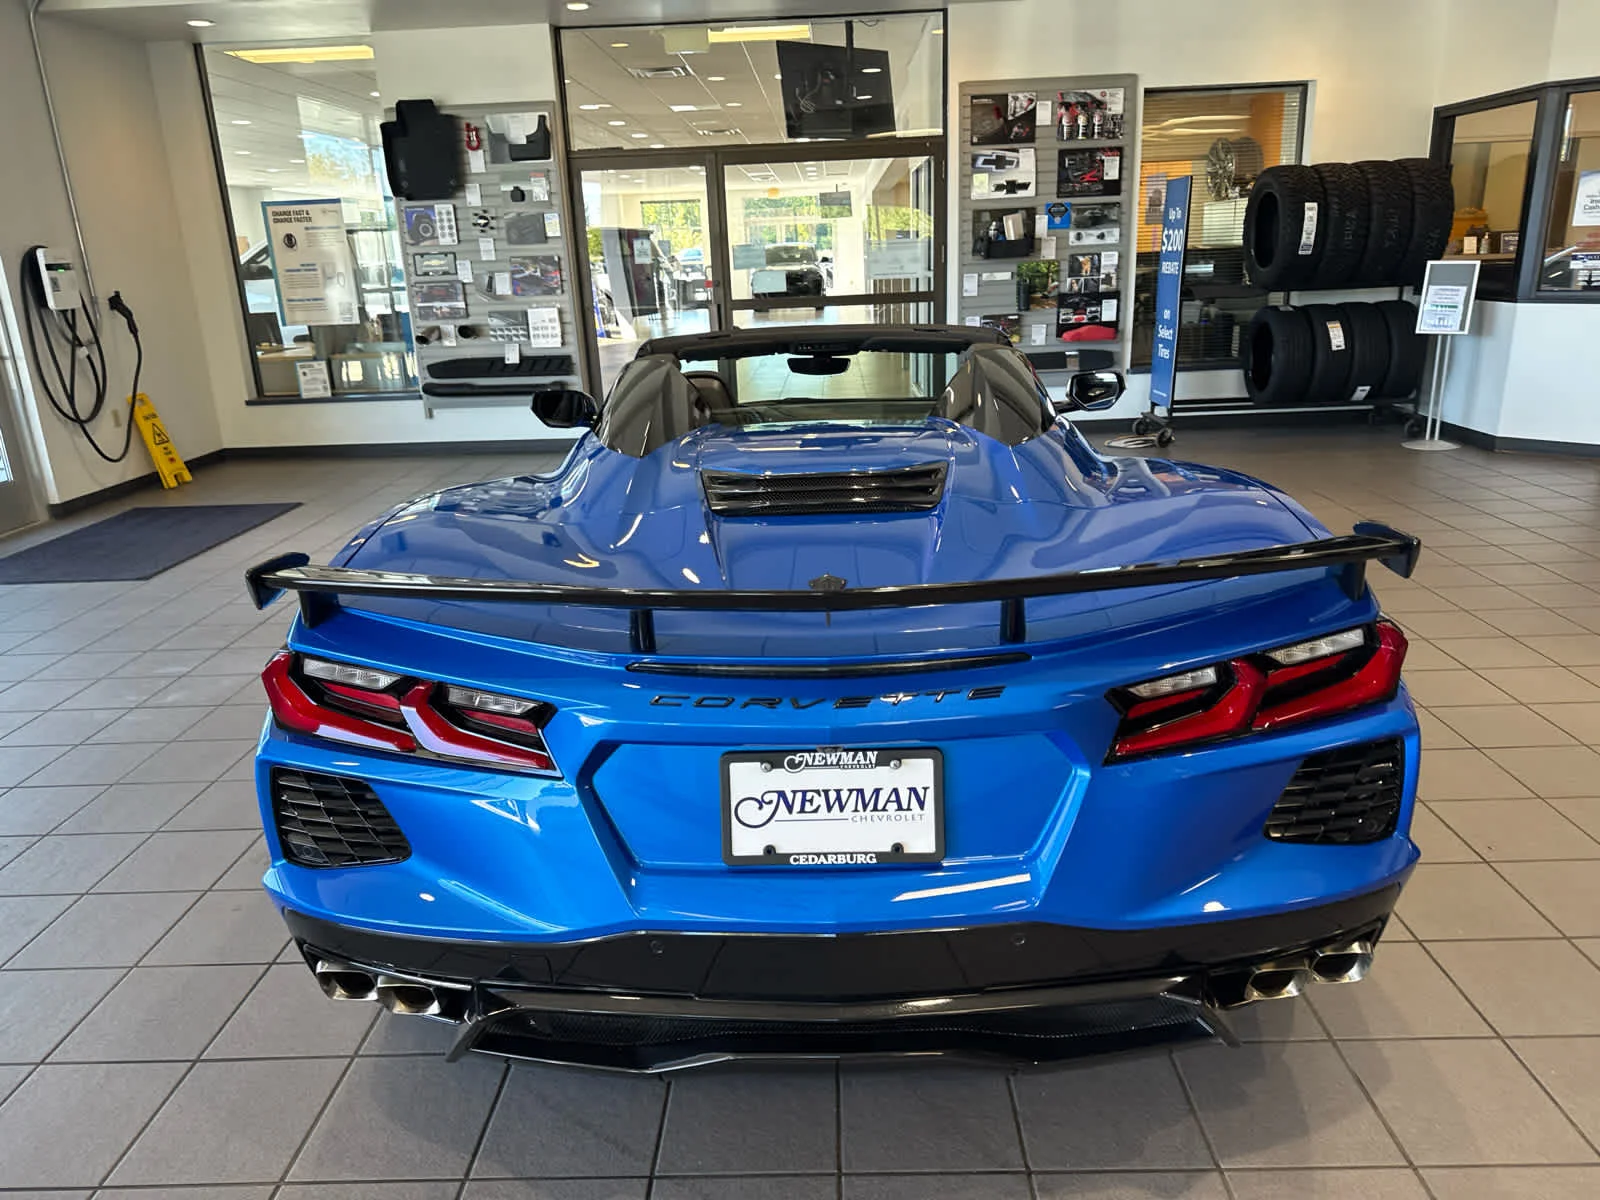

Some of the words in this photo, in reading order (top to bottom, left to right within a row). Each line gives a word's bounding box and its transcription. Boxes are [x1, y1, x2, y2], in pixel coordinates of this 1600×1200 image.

[1168, 207, 1176, 223] Up
[1175, 207, 1182, 219] To
[1161, 227, 1184, 254] $200
[1161, 261, 1179, 275] REBATE
[1163, 309, 1171, 320] on
[1157, 324, 1173, 341] Select
[1158, 343, 1170, 359] Tires
[649, 686, 1007, 709] CORVETTE
[784, 751, 878, 773] NEWMAN
[734, 786, 930, 828] NEWMAN
[851, 813, 925, 823] CHEVROLET
[789, 853, 877, 865] CEDARBURG
